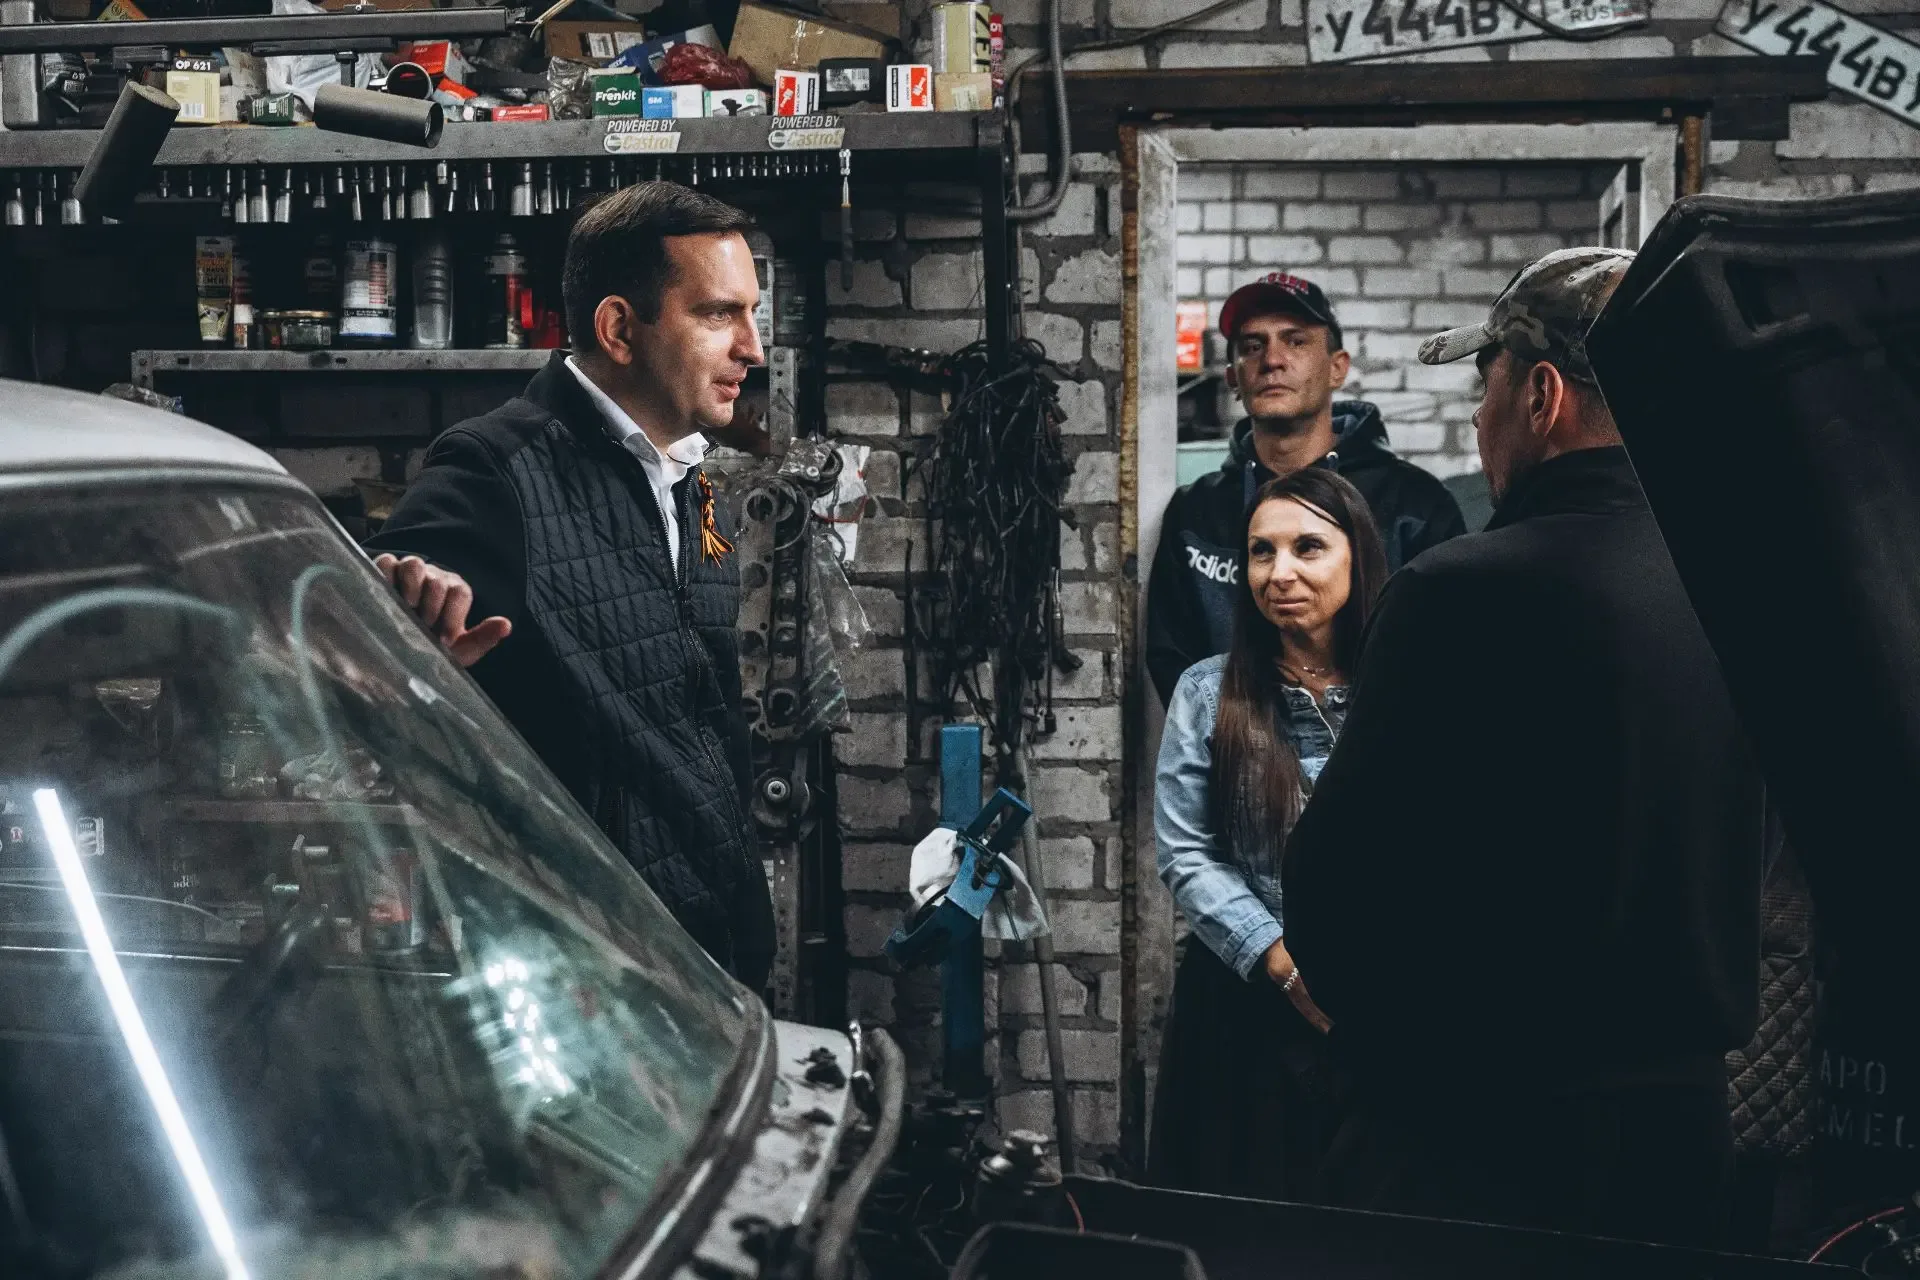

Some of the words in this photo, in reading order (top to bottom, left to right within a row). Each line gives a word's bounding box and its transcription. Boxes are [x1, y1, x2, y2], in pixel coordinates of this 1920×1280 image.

[1570, 6, 1610, 22] RUS
[175, 60, 191, 70] OP
[193, 60, 211, 71] 621
[595, 89, 637, 102] Frenkit
[607, 120, 659, 132] POWERED
[660, 120, 677, 132] BY
[771, 115, 824, 129] POWERED
[825, 115, 840, 127] BY
[622, 133, 676, 151] Castrol
[787, 130, 841, 147] Castrol
